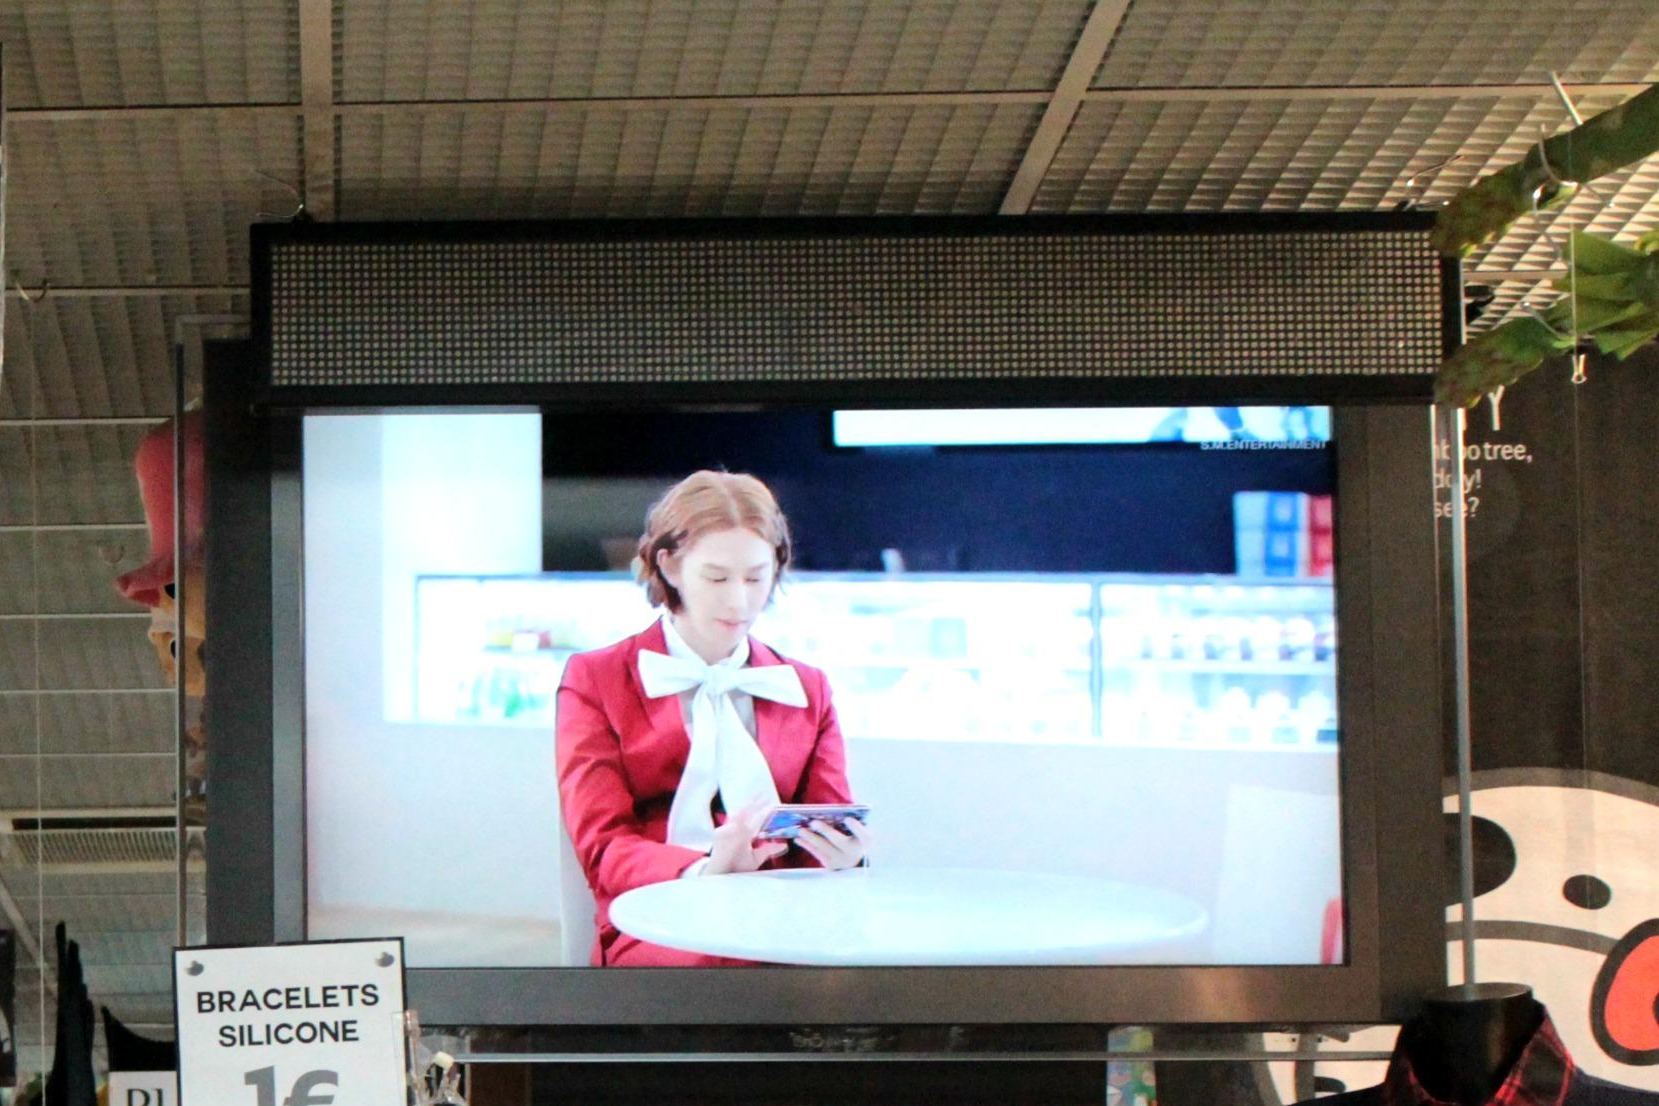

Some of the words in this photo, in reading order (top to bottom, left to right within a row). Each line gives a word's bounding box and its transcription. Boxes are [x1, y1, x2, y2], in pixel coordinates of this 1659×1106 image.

[1483, 441, 1533, 464] tree,
[196, 983, 380, 1014] BRACELETS
[218, 1019, 360, 1047] SILICONE
